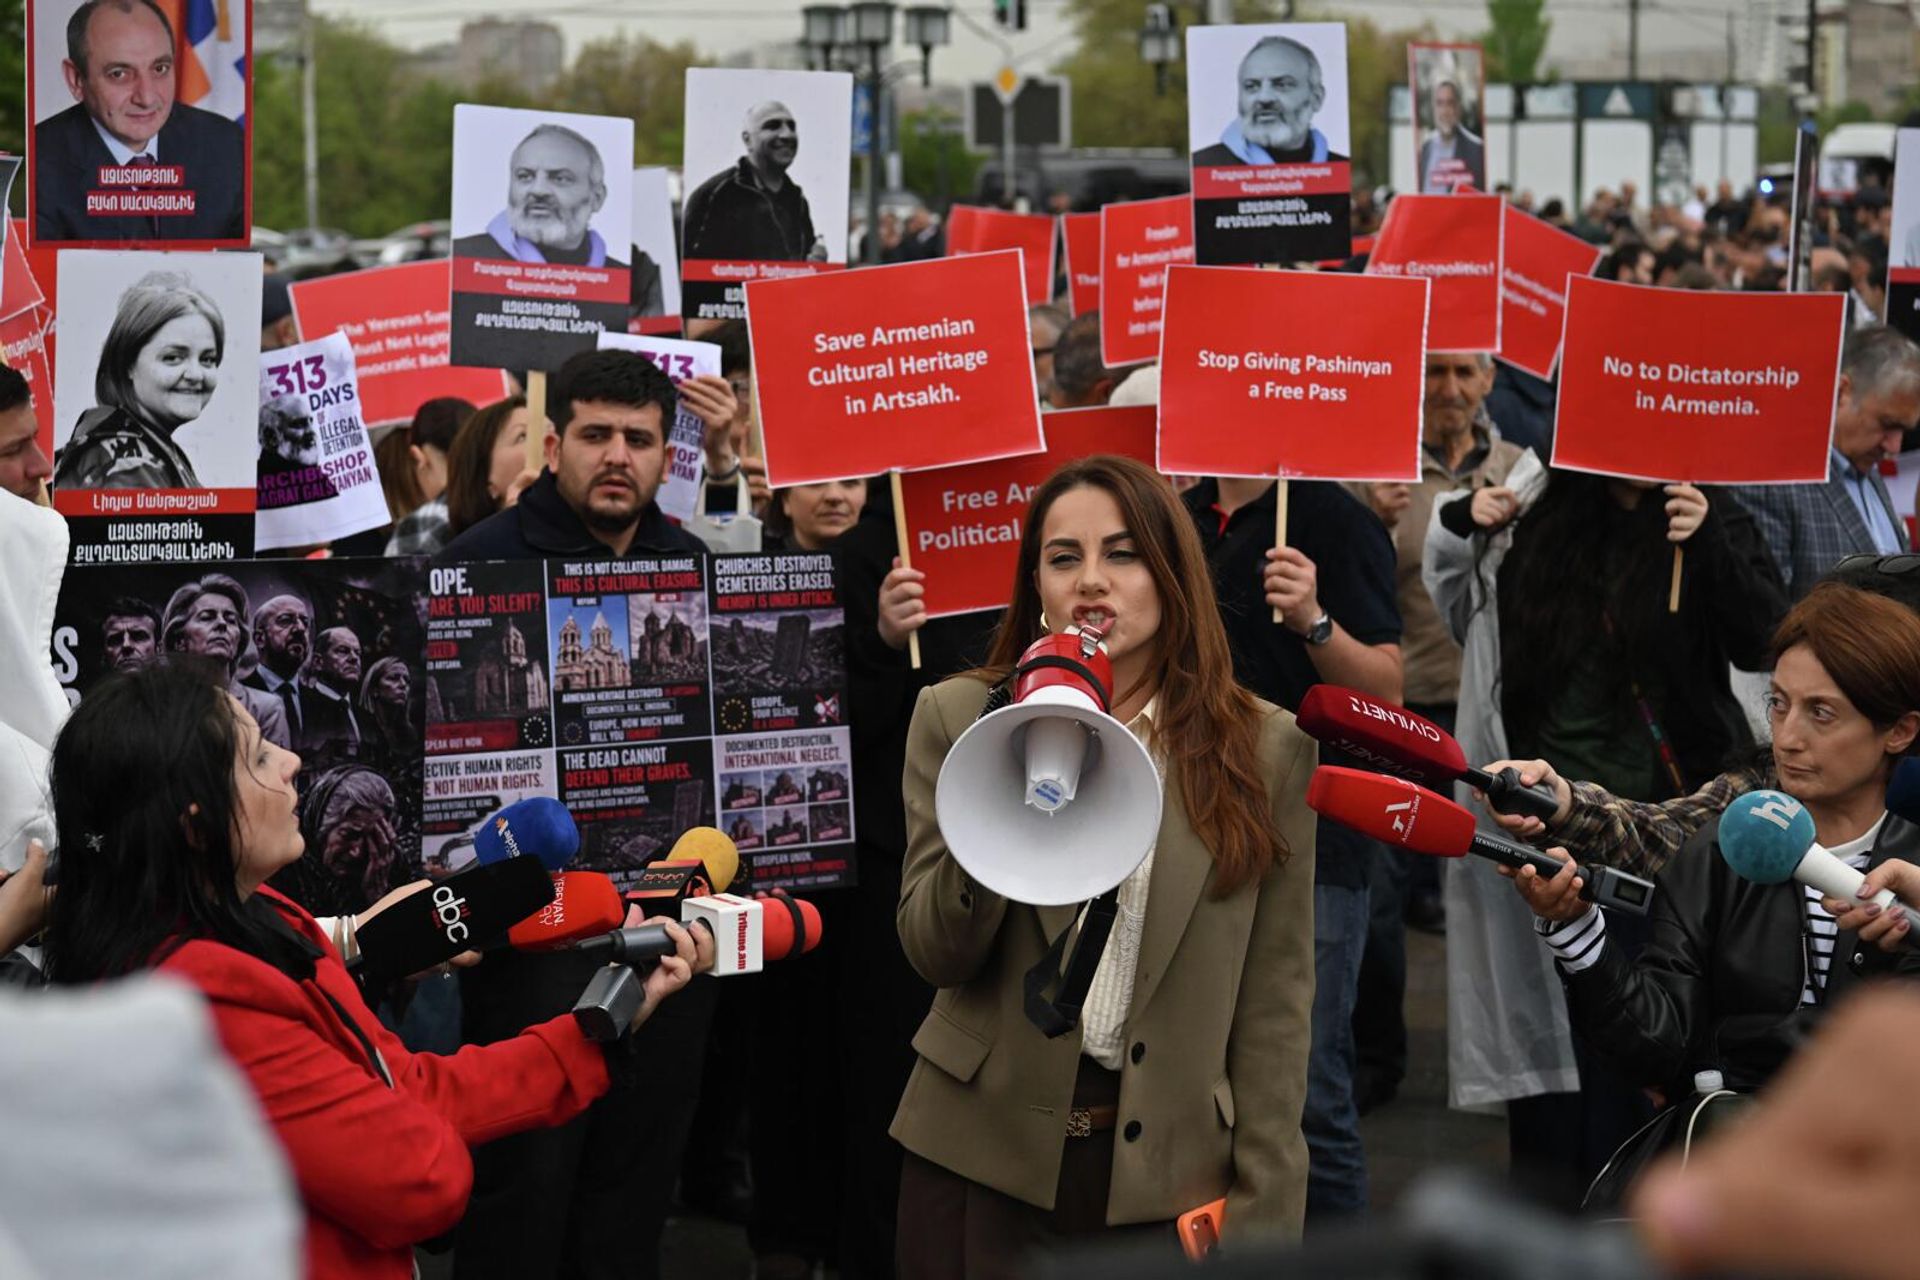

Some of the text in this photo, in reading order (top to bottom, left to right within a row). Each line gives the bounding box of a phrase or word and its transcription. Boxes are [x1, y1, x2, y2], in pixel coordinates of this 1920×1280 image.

[100, 168, 178, 184] ԱԶԱՏՈՒԹՅՈՒՆ
[87, 195, 195, 211] ԲԱԿՈ ՍԱՀԱԿՅԱՆԻՆ
[1406, 260, 1494, 277] Geopolitics!
[814, 318, 975, 353] Save Armenian
[267, 354, 327, 398] 313
[808, 350, 988, 386] Cultural Heritage
[1198, 350, 1392, 378] Stop Giving Pashinyan
[1603, 356, 1800, 389] No to Dictatorship
[309, 383, 354, 412] DAYS
[845, 383, 960, 415] in Artsakh.
[1249, 381, 1348, 402] a Free Pass
[1636, 390, 1760, 415] in Armenia.
[319, 415, 361, 441] ILLEGAL
[322, 431, 364, 456] DETENTION
[93, 492, 218, 511] Լիդյա Մանթաշյան
[942, 489, 998, 512] Free
[918, 518, 1021, 552] Political
[564, 558, 698, 576] THIS IS NOT COLLATERAL DAMAGE.
[715, 555, 835, 575] CHURCHES DESTROYED.
[430, 567, 473, 597] OPE,
[555, 571, 702, 593] THIS IS CULTURAL ERASURE.
[716, 572, 835, 594] CEMETERIES ERASED.
[430, 592, 540, 617] ARE YOU SILENT?
[1362, 701, 1440, 742] CIVILNET
[564, 746, 667, 770] THE DEAD CANNOT
[724, 747, 842, 769] INTERNATIONAL NEGLECT.
[725, 738, 779, 753] DOCUMENTED
[425, 755, 543, 778] ECTIVE HUMAN RIGHTS
[565, 769, 609, 788] DEFEND
[612, 766, 644, 785] THEIR
[434, 778, 456, 796] NOT
[459, 775, 499, 794] HUMAN
[502, 772, 545, 790] RIGHTS.
[503, 830, 521, 858] alpha
[432, 886, 469, 944] abc
[737, 911, 748, 970] Tribune.am
